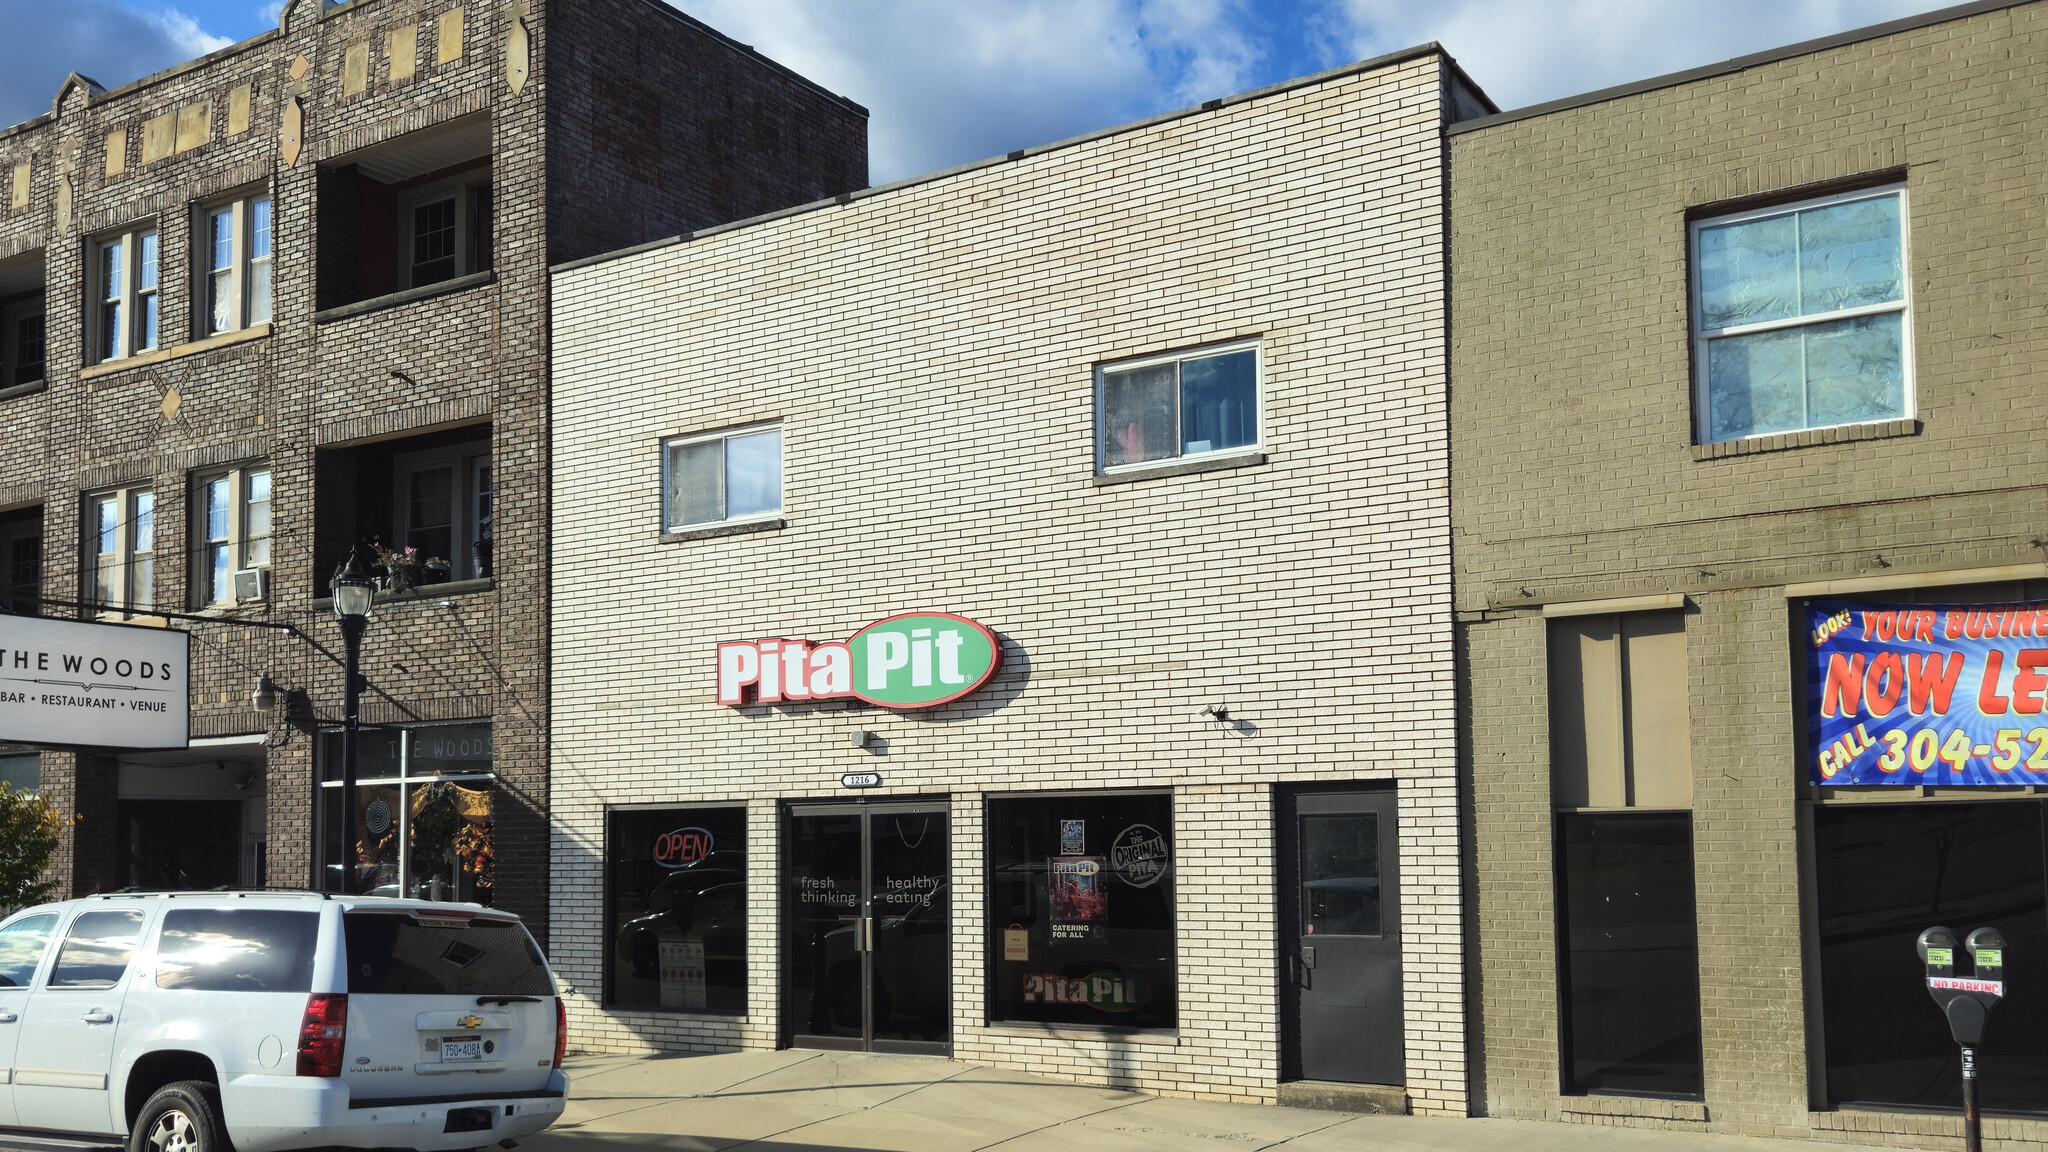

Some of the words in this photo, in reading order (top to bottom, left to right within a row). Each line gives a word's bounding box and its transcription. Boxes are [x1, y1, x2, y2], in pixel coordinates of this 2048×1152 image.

[1812, 608, 1852, 647] LOOK!
[1861, 609, 1938, 643] YOUR
[0, 649, 49, 670] THE
[63, 655, 171, 681] WOODS
[719, 641, 850, 701] Pita
[867, 628, 965, 690] Pit
[1820, 650, 1966, 718] NOW
[1976, 648, 2048, 717] LE
[0, 691, 26, 703] BAR
[41, 694, 117, 709] RESTAURANT
[130, 700, 167, 712] VENUE
[387, 740, 422, 759] TE
[1818, 723, 1877, 779] CALL
[850, 775, 870, 785] 1216
[655, 833, 709, 862] OPEN
[1129, 834, 1144, 845] THE
[1115, 837, 1165, 864] ORIGINAL
[1053, 862, 1078, 873] Pita
[1078, 861, 1097, 873] Pit
[1128, 860, 1159, 878] PITA
[801, 876, 835, 888] fresh
[886, 875, 940, 889] healthy
[801, 891, 856, 907] thinking
[886, 892, 931, 907] eating
[1052, 924, 1089, 932] CATERING
[1025, 974, 1088, 1002] Pita
[1092, 976, 1137, 1003] Pit
[1933, 980, 1949, 989] NO
[1952, 980, 2000, 994] PARKING
